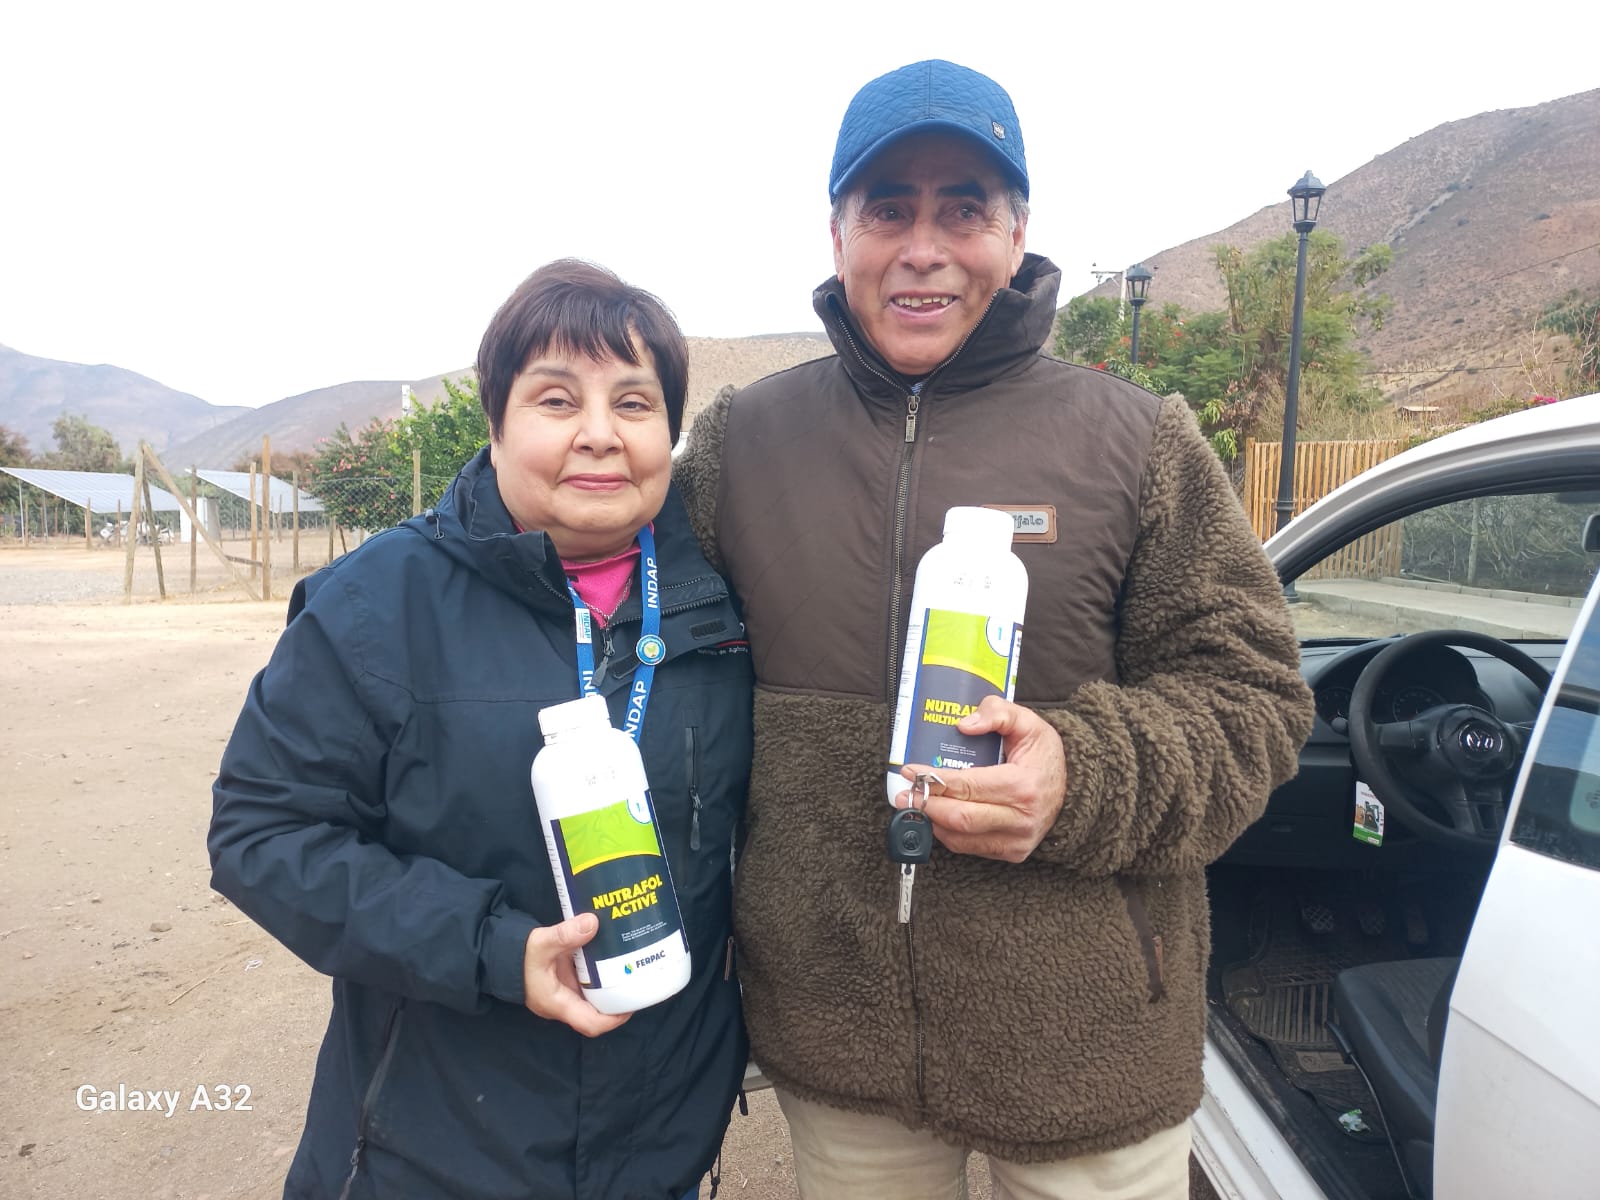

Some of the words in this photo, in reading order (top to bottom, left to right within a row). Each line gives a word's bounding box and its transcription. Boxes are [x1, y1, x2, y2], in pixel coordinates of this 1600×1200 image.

[1012, 514, 1044, 529] falo
[646, 556, 658, 609] INDAP
[583, 612, 592, 640] INDAP
[625, 680, 647, 738] NDAP
[923, 711, 961, 726] MULTIM
[925, 698, 978, 716] NUTRA
[592, 874, 663, 909] NUTRAFOL
[611, 891, 658, 920] ACTIVE
[635, 950, 666, 969] FERPAC
